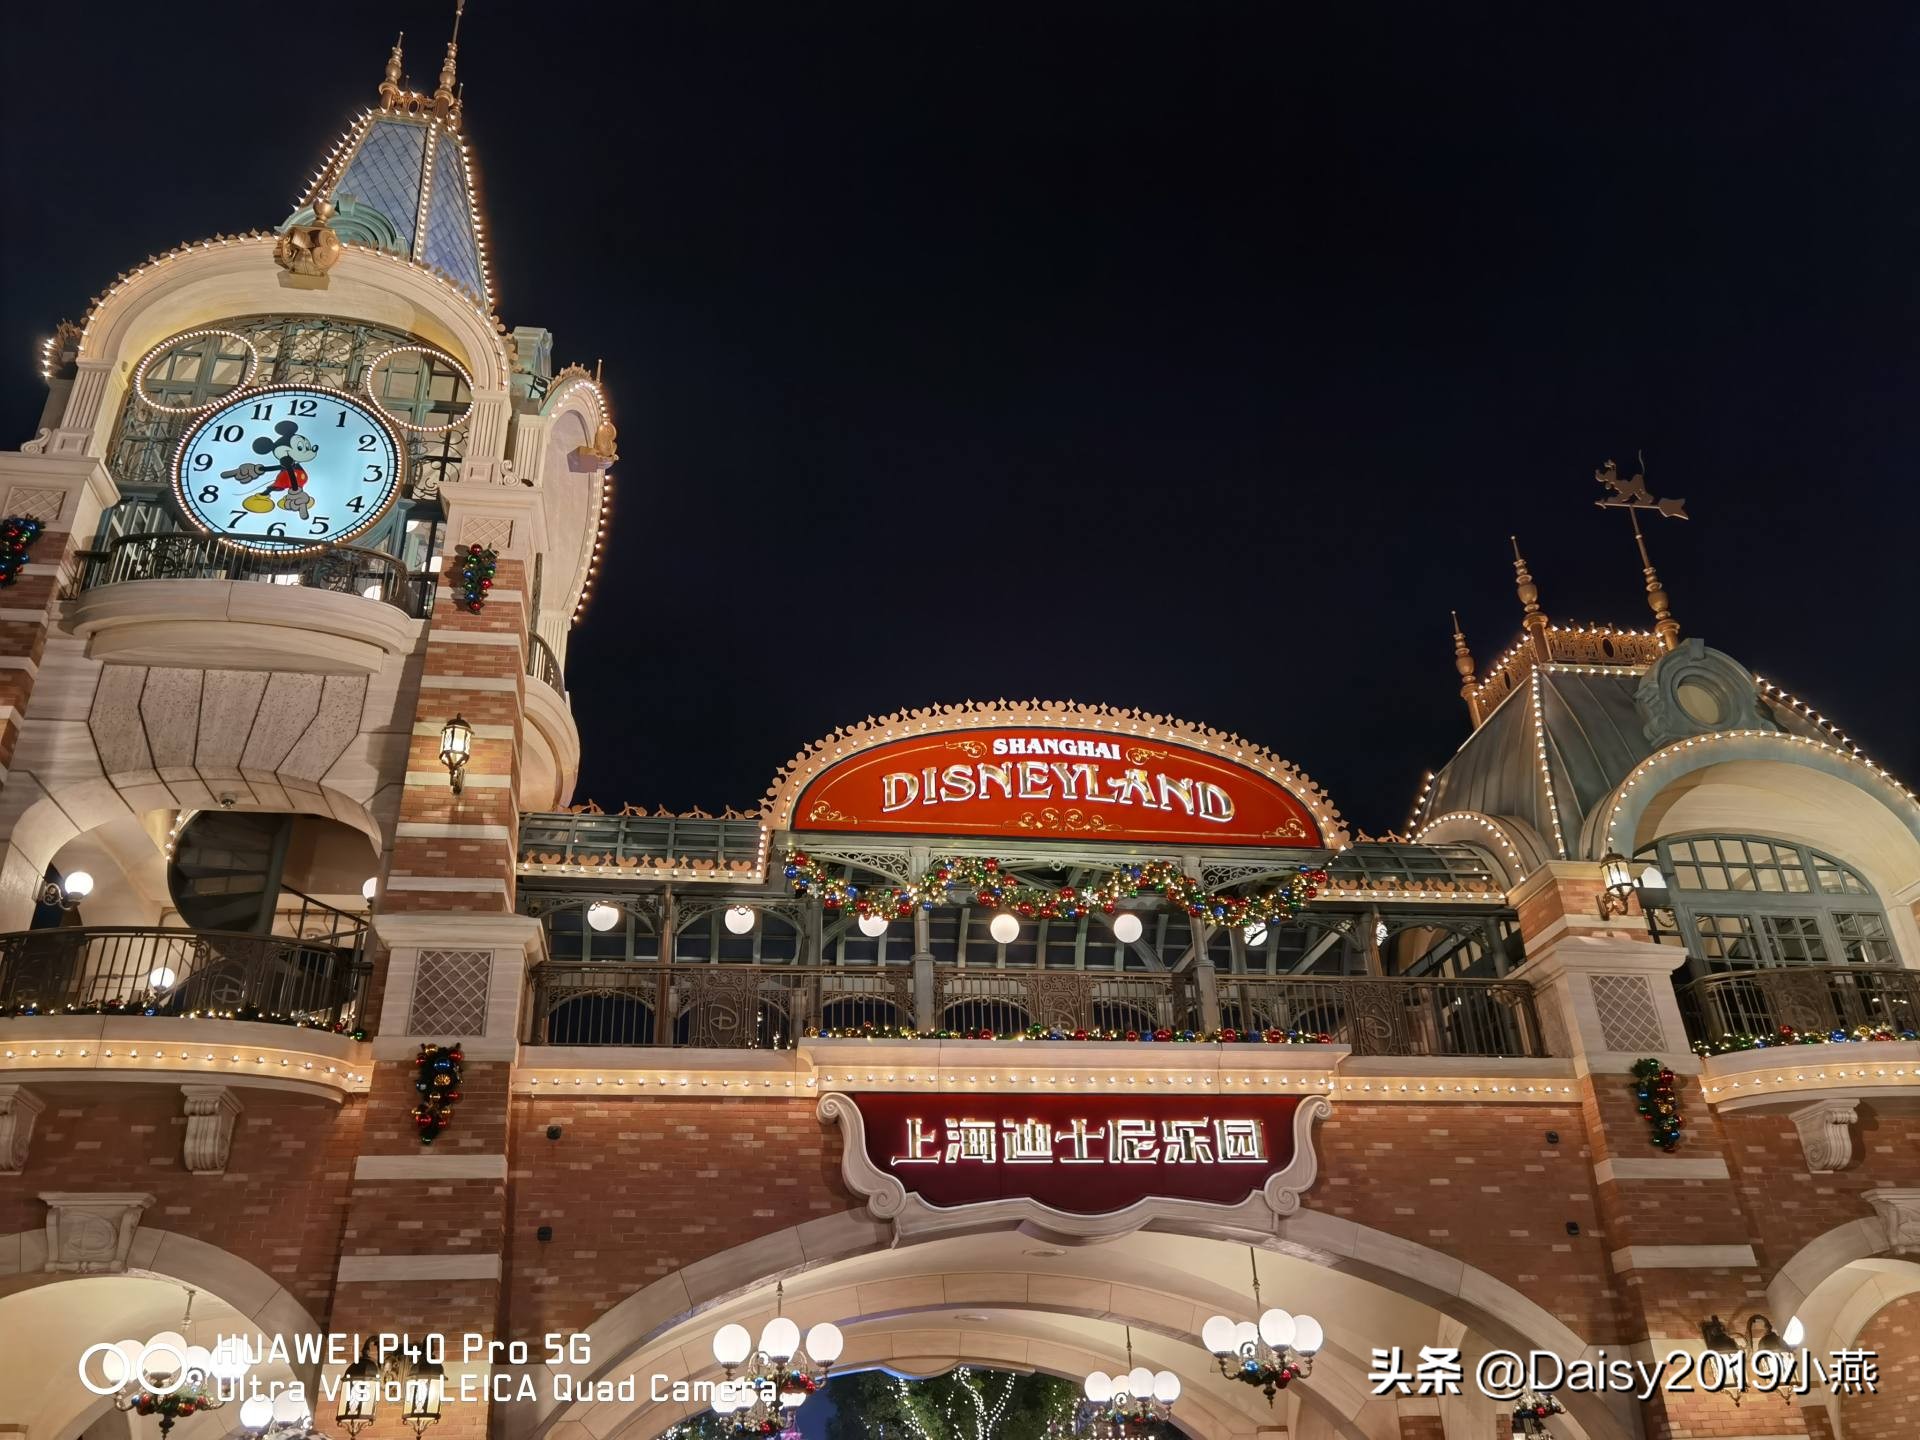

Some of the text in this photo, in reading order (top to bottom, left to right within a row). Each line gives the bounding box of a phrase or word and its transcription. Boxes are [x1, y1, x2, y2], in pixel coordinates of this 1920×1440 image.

[250, 403, 273, 421] 11
[288, 399, 318, 418] 12
[335, 411, 347, 428] 1
[211, 424, 244, 443] 10
[358, 434, 377, 452] 2
[193, 453, 213, 472] 9
[363, 465, 383, 483] 3
[198, 485, 219, 504] 8
[345, 495, 365, 513] 4
[227, 510, 248, 529] 7
[309, 517, 330, 535] 5
[266, 522, 287, 537] 6
[992, 738, 1121, 760] SHANGHAI
[882, 761, 1235, 822] DISNEYLAND
[891, 1116, 1268, 1165] 上海迪士尼乐园
